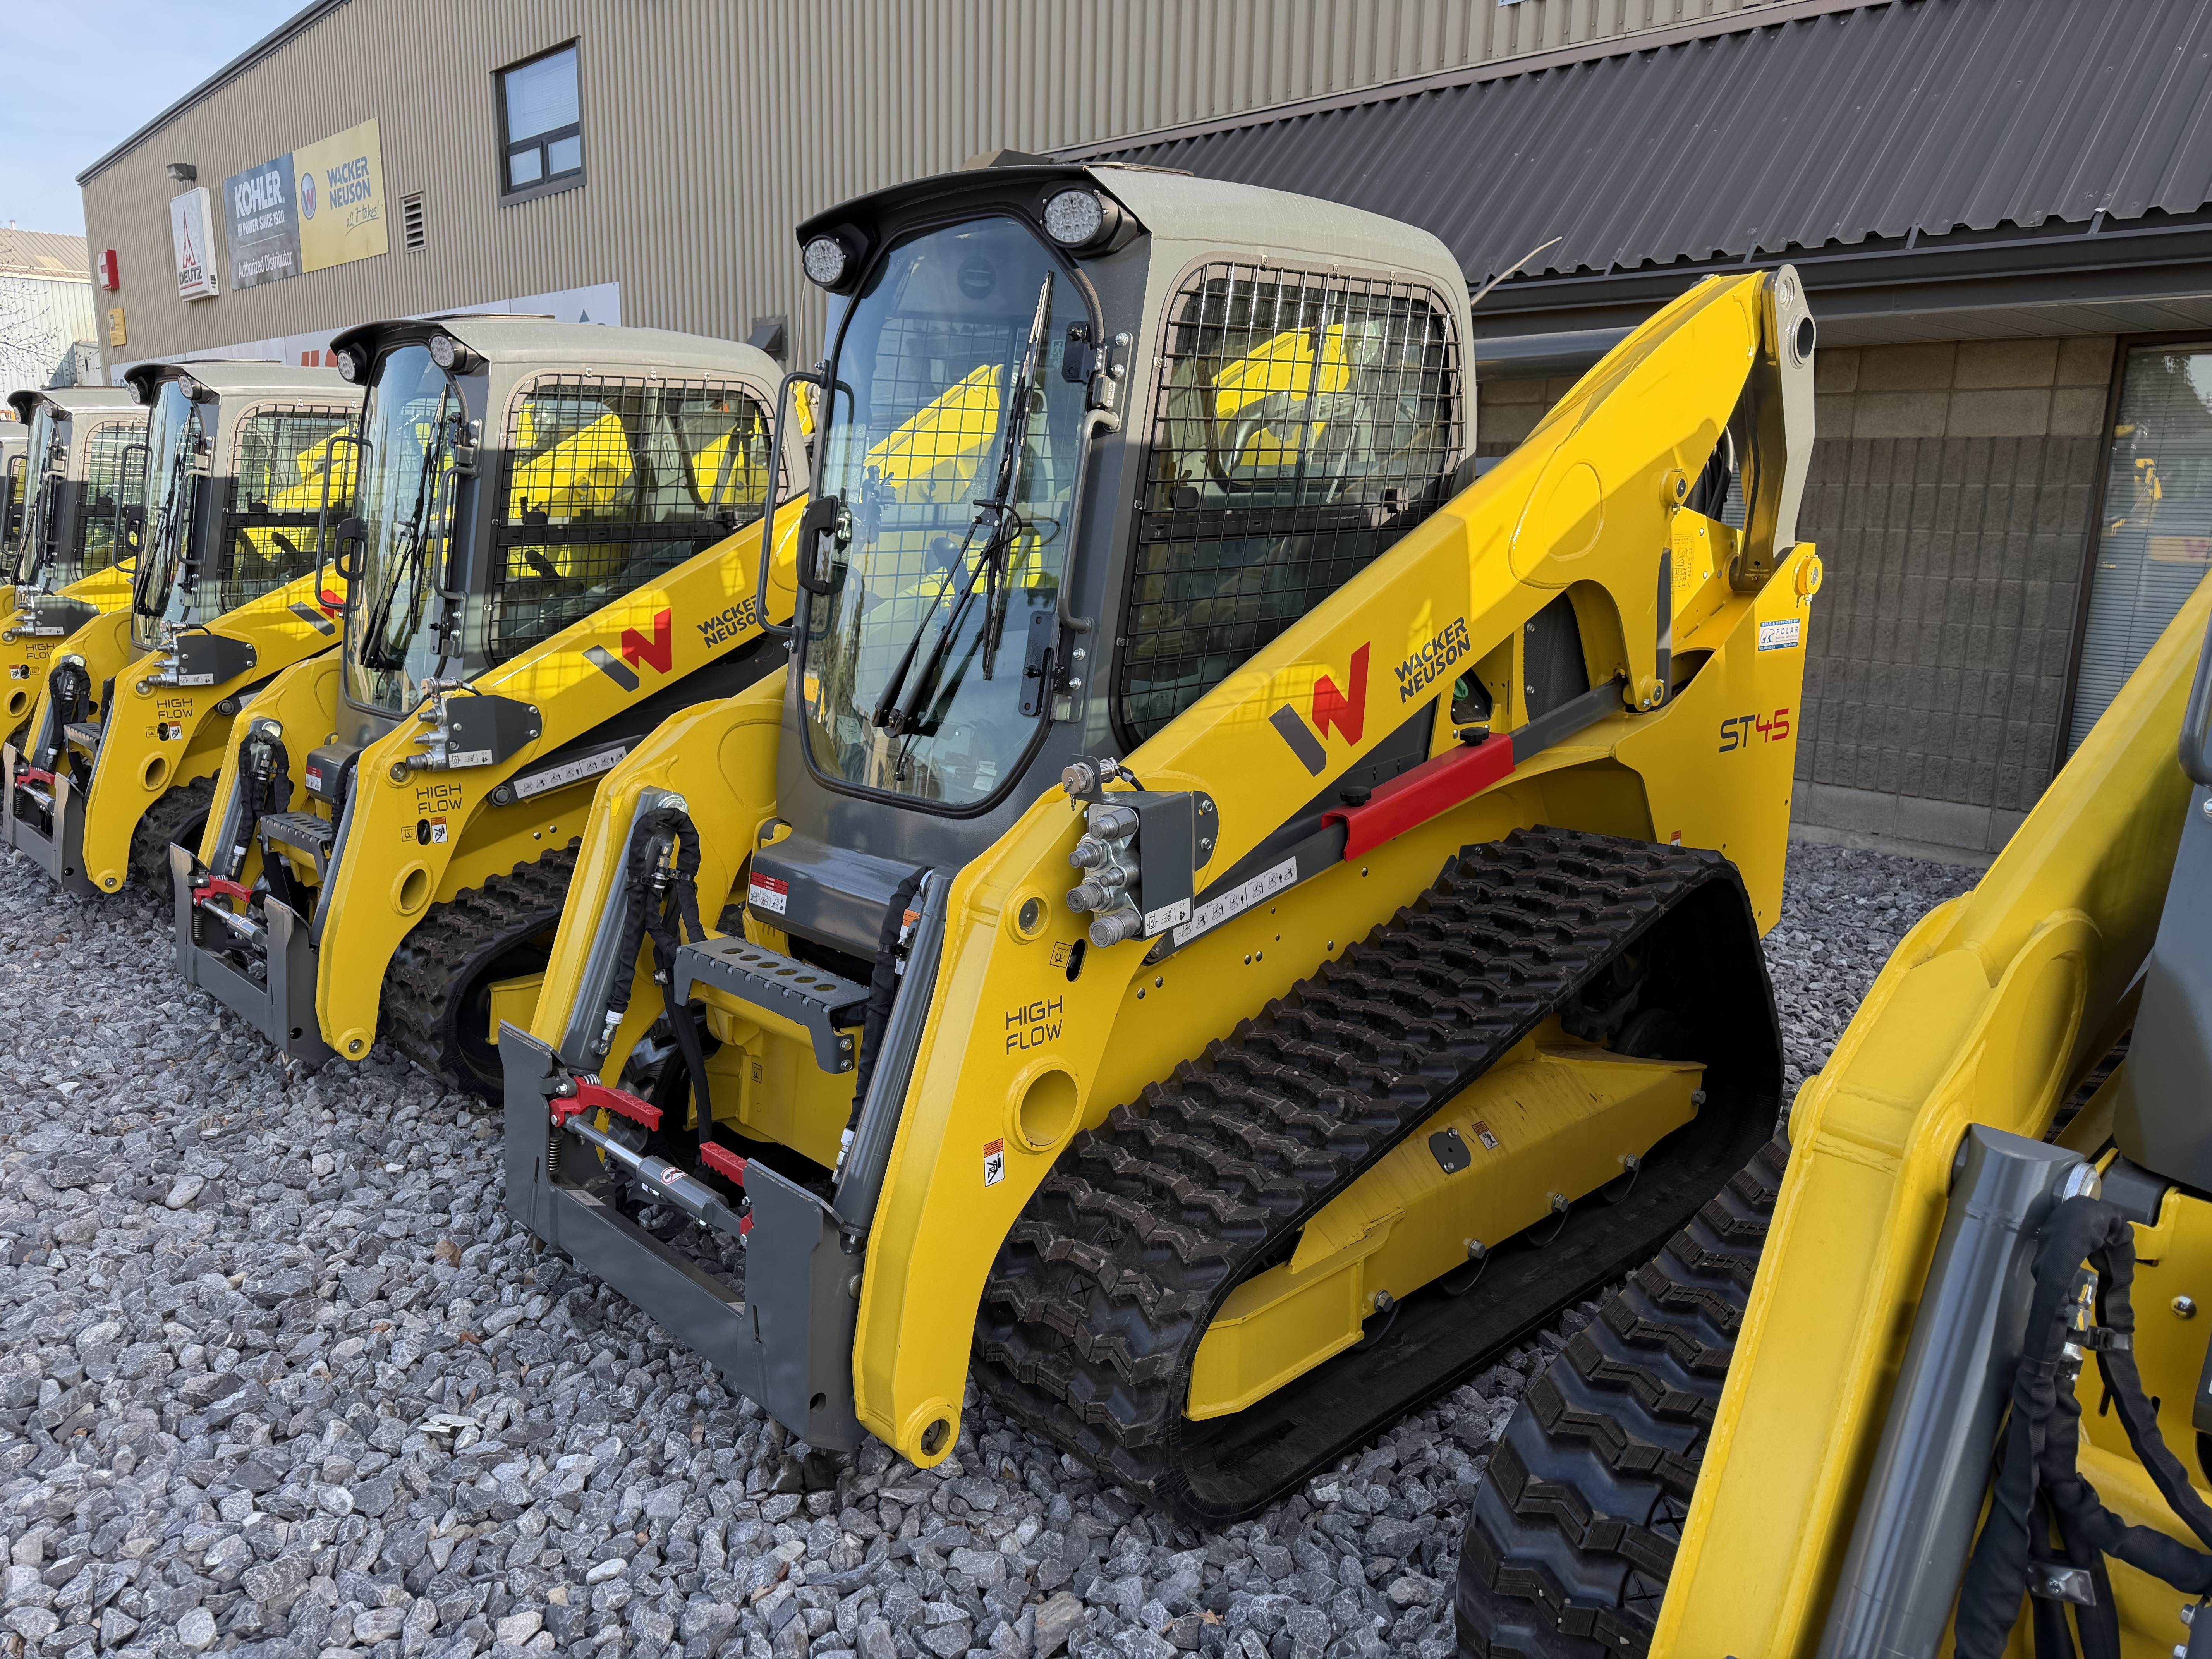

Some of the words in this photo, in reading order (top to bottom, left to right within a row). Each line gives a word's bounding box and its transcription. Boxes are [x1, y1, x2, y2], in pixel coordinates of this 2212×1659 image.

[326, 156, 369, 188] WACKER
[329, 178, 371, 210] NEUSON
[237, 223, 243, 237] IN
[259, 213, 273, 230] SINCE
[273, 209, 286, 225] 1920.
[362, 199, 379, 220] takes!
[179, 266, 203, 285] DEUTZ
[239, 256, 264, 279] Authorized
[264, 249, 292, 271] Distributor
[1776, 626, 1798, 635] POLAR
[26, 643, 55, 651] HIGH
[1394, 617, 1468, 682] WACKER
[1400, 633, 1470, 704] NEUSON
[157, 698, 192, 709] HIGH
[158, 708, 193, 720] FLOW
[1719, 708, 1790, 753] ST45
[416, 783, 462, 800] HIGH
[418, 797, 462, 815] FLOW
[1006, 995, 1063, 1030] HIGH
[1006, 1019, 1063, 1055] FLOW
